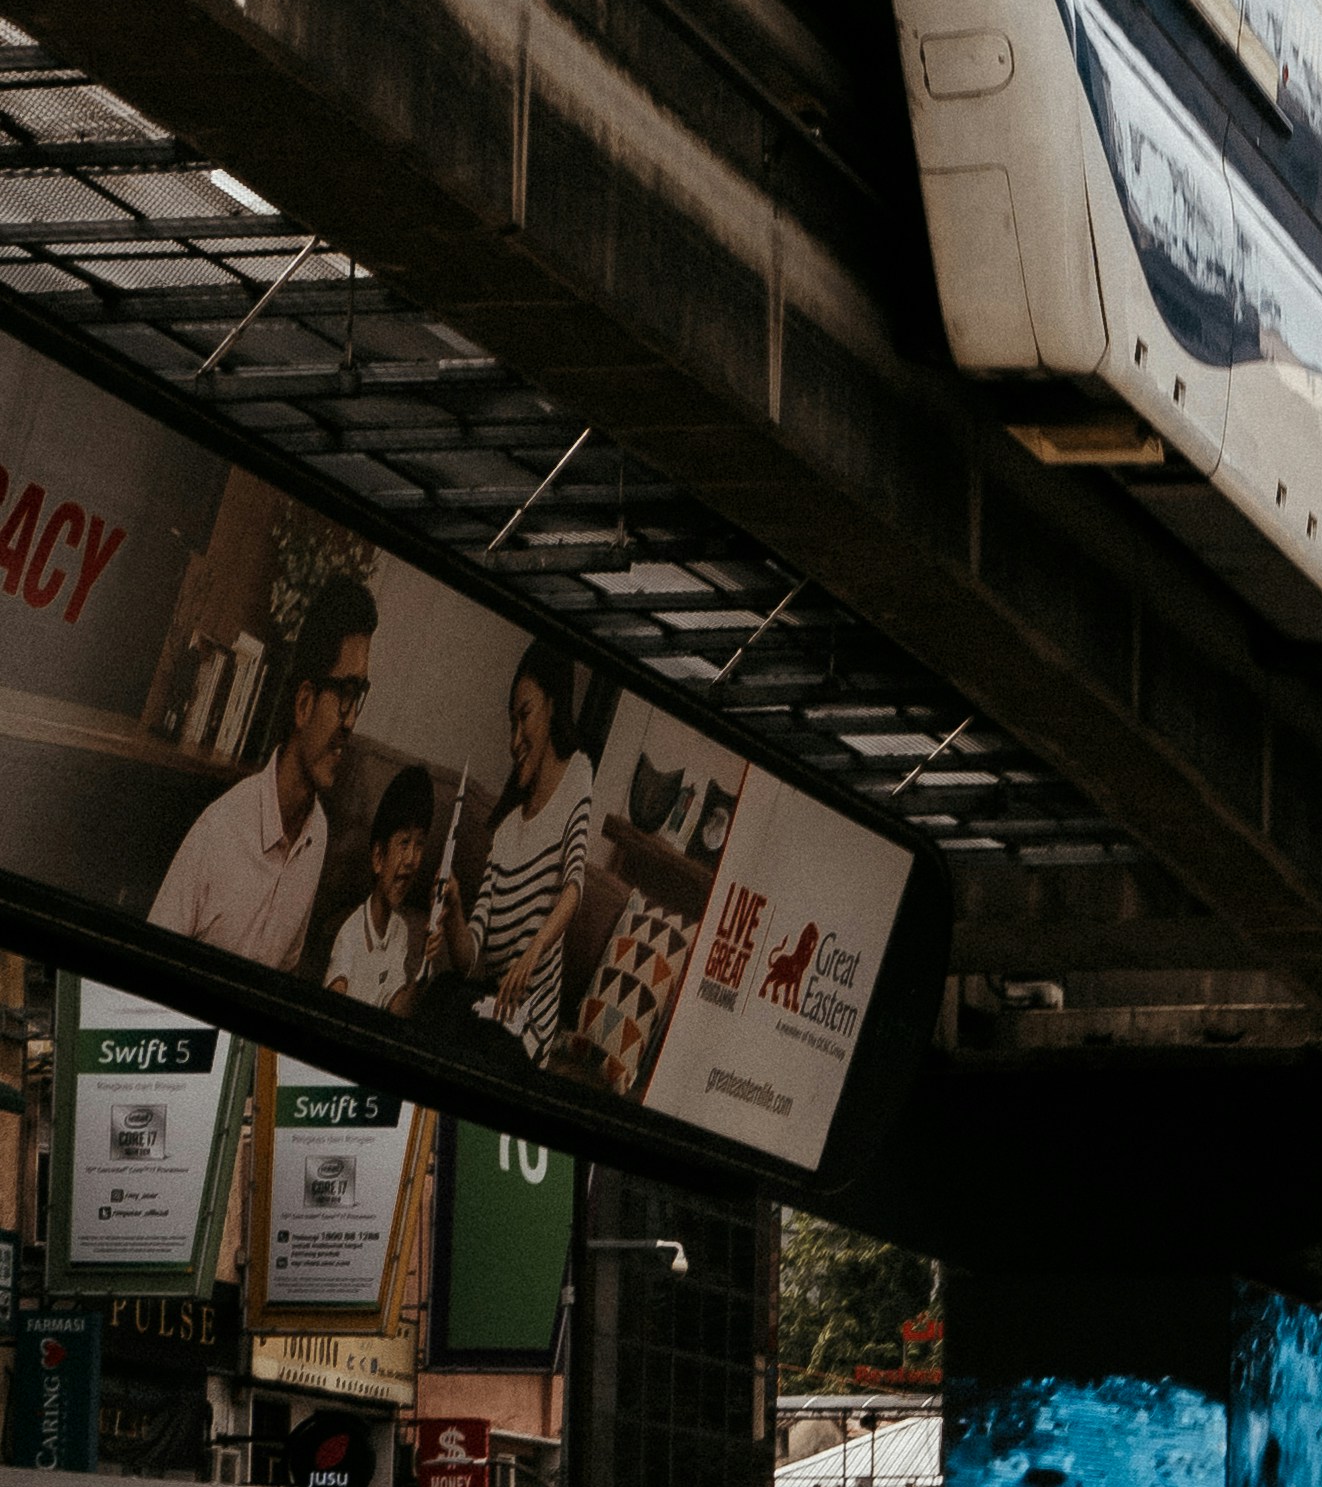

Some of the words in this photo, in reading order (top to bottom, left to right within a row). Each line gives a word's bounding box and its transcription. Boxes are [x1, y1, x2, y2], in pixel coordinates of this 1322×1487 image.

[717, 881, 767, 950] LIVE
[704, 939, 751, 990] GREAT
[815, 931, 862, 989] Great
[800, 975, 858, 1039] Eastern
[98, 1039, 168, 1070] Swift
[174, 1040, 191, 1064] 5
[293, 1095, 358, 1124] Swift
[364, 1096, 380, 1119] 5
[26, 1316, 86, 1333] FARMASI
[109, 1298, 218, 1346] PULSE
[35, 1374, 61, 1471] CARING
